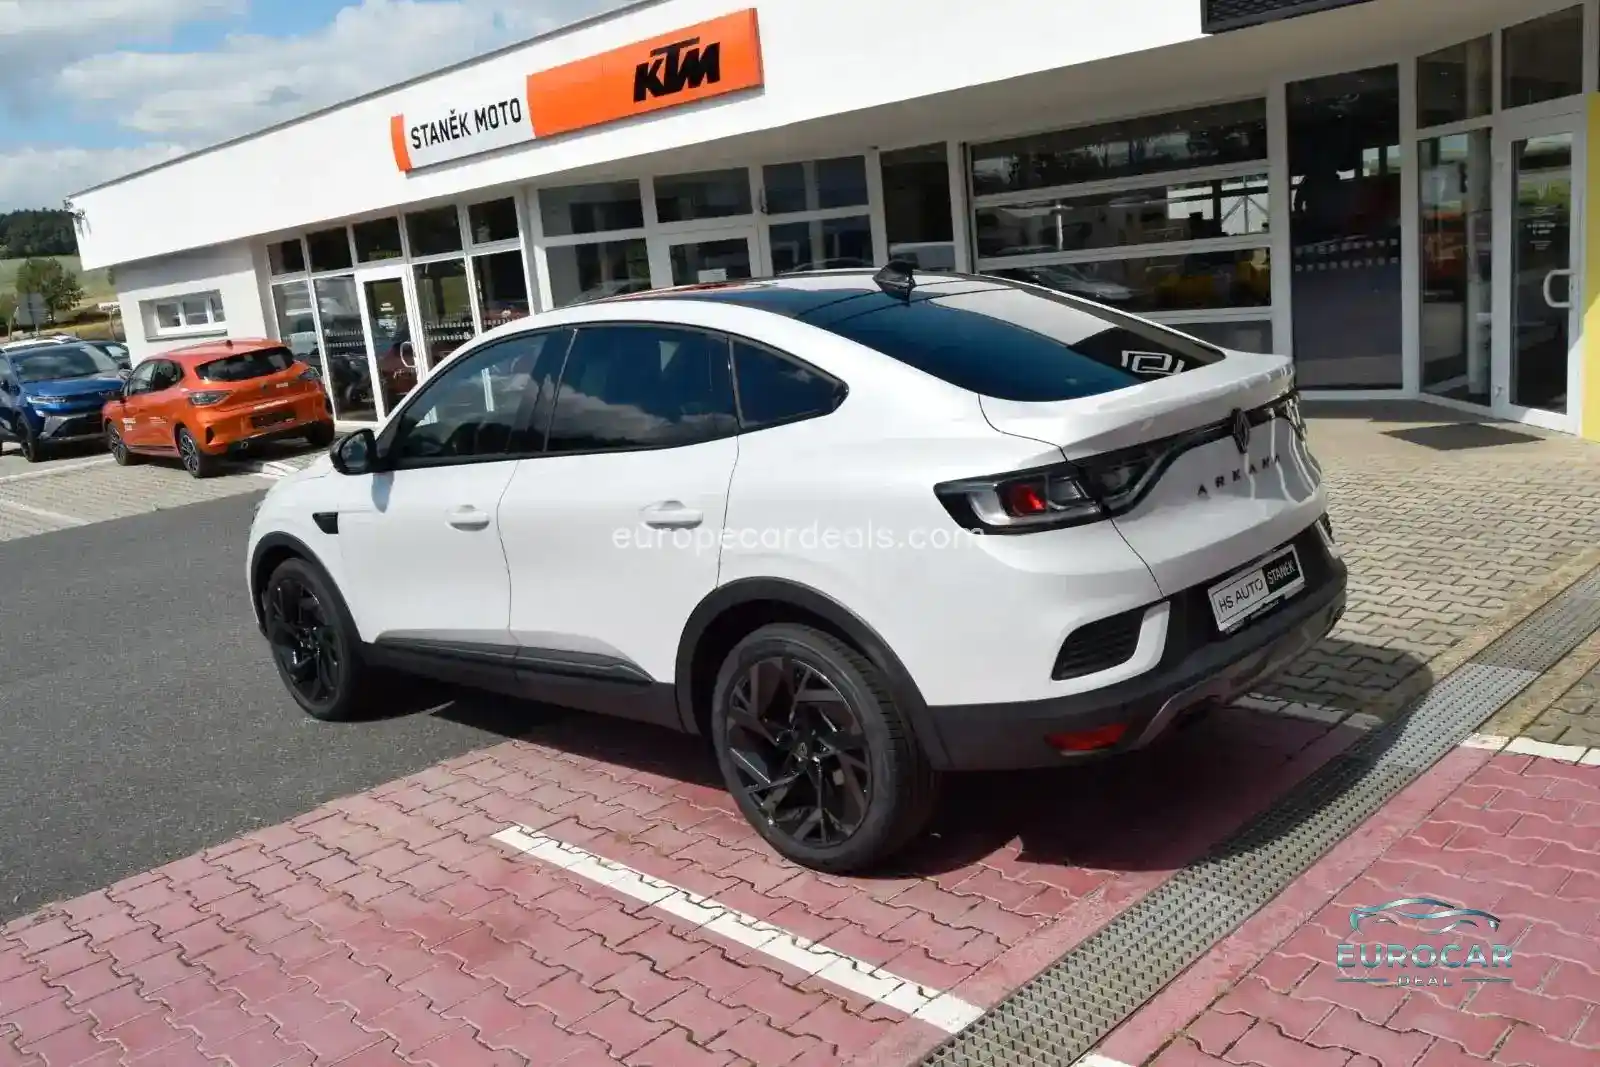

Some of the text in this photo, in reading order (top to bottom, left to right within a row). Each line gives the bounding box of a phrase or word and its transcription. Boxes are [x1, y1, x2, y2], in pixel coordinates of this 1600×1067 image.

[633, 37, 720, 103] KTM
[411, 98, 522, 149] STANĚK MOTO
[1197, 453, 1280, 497] ARKANA
[1219, 595, 1234, 613] HS
[1235, 578, 1264, 604] AUTO
